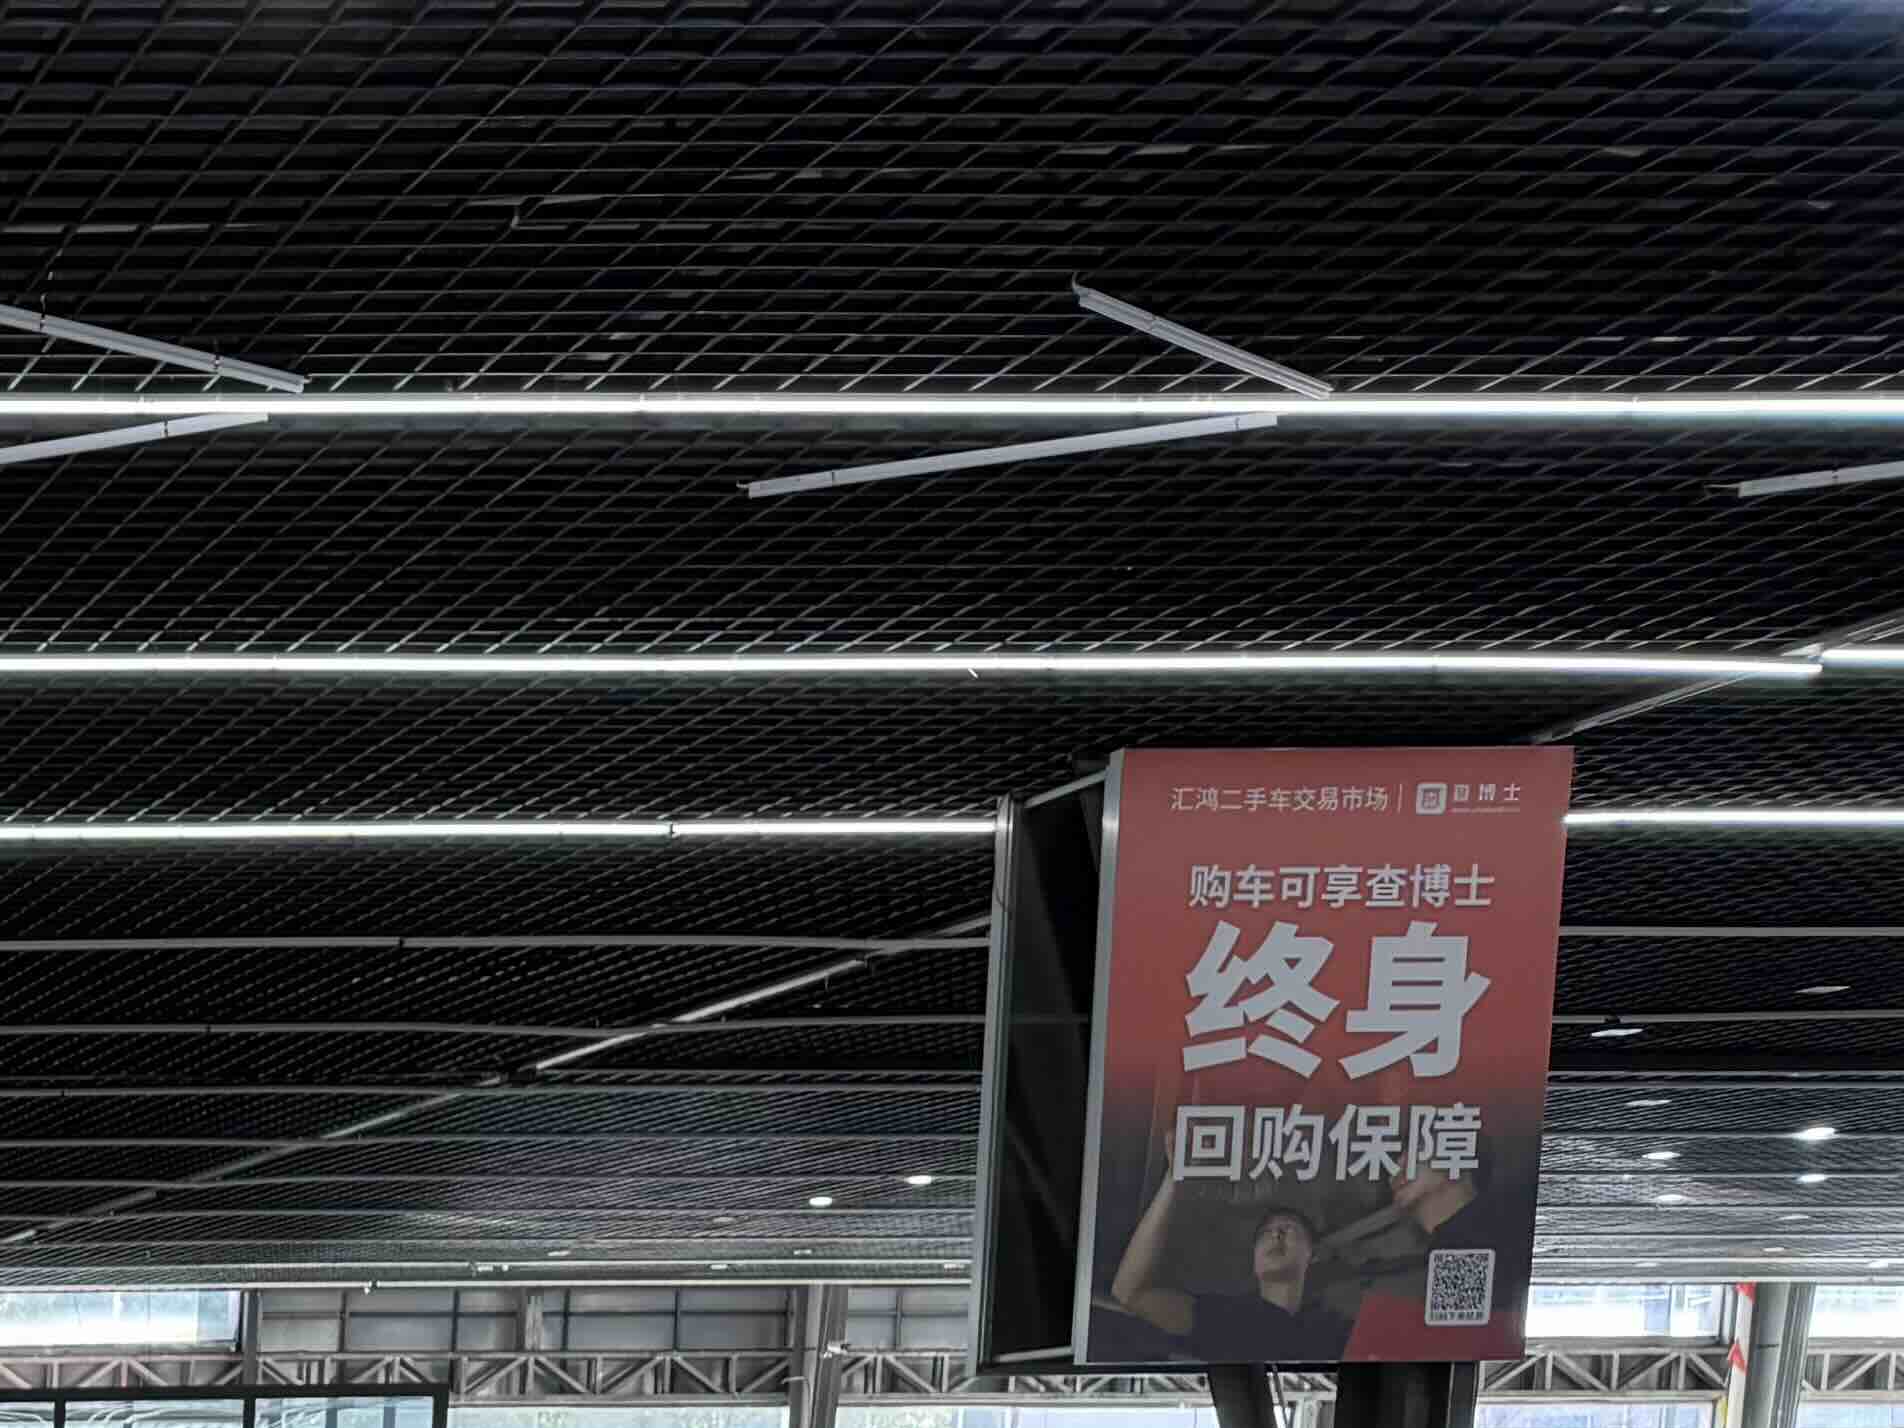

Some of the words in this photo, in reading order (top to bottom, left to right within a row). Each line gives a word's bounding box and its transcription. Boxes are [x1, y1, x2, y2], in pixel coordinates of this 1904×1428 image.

[1169, 787, 1388, 812] 汇鸿二手车交易市场
[1188, 864, 1495, 909] 购车可享查博士
[1182, 920, 1491, 1080] 终身
[1172, 1103, 1483, 1182] 回购保障
